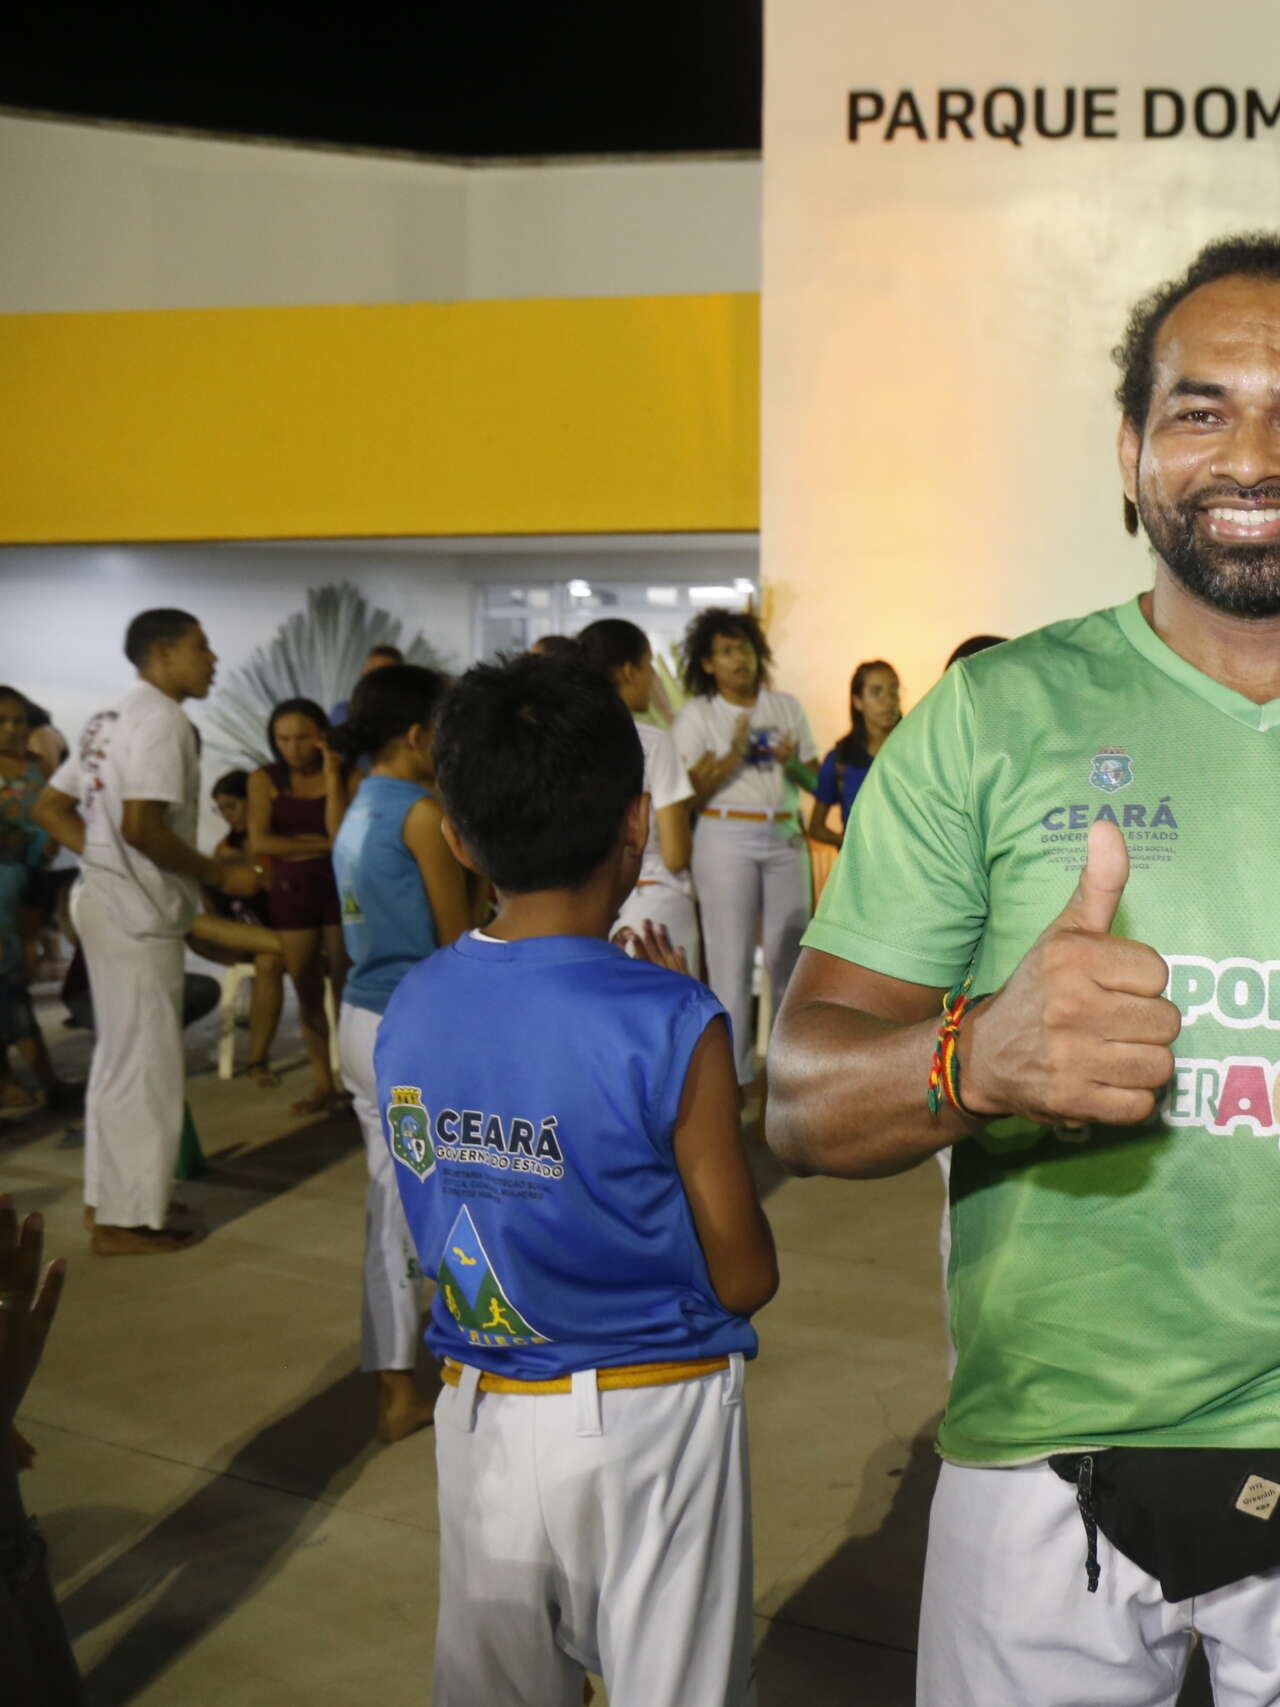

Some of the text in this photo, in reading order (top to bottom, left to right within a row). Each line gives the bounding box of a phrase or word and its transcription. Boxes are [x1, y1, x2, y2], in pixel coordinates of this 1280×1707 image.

[848, 86, 1118, 147] PARQUE
[1041, 795, 1178, 830] CEARÁ
[1040, 831, 1179, 843] GOVERN ESTADO
[436, 1109, 564, 1162] CEARÁ
[512, 1157, 564, 1179] ESTADO
